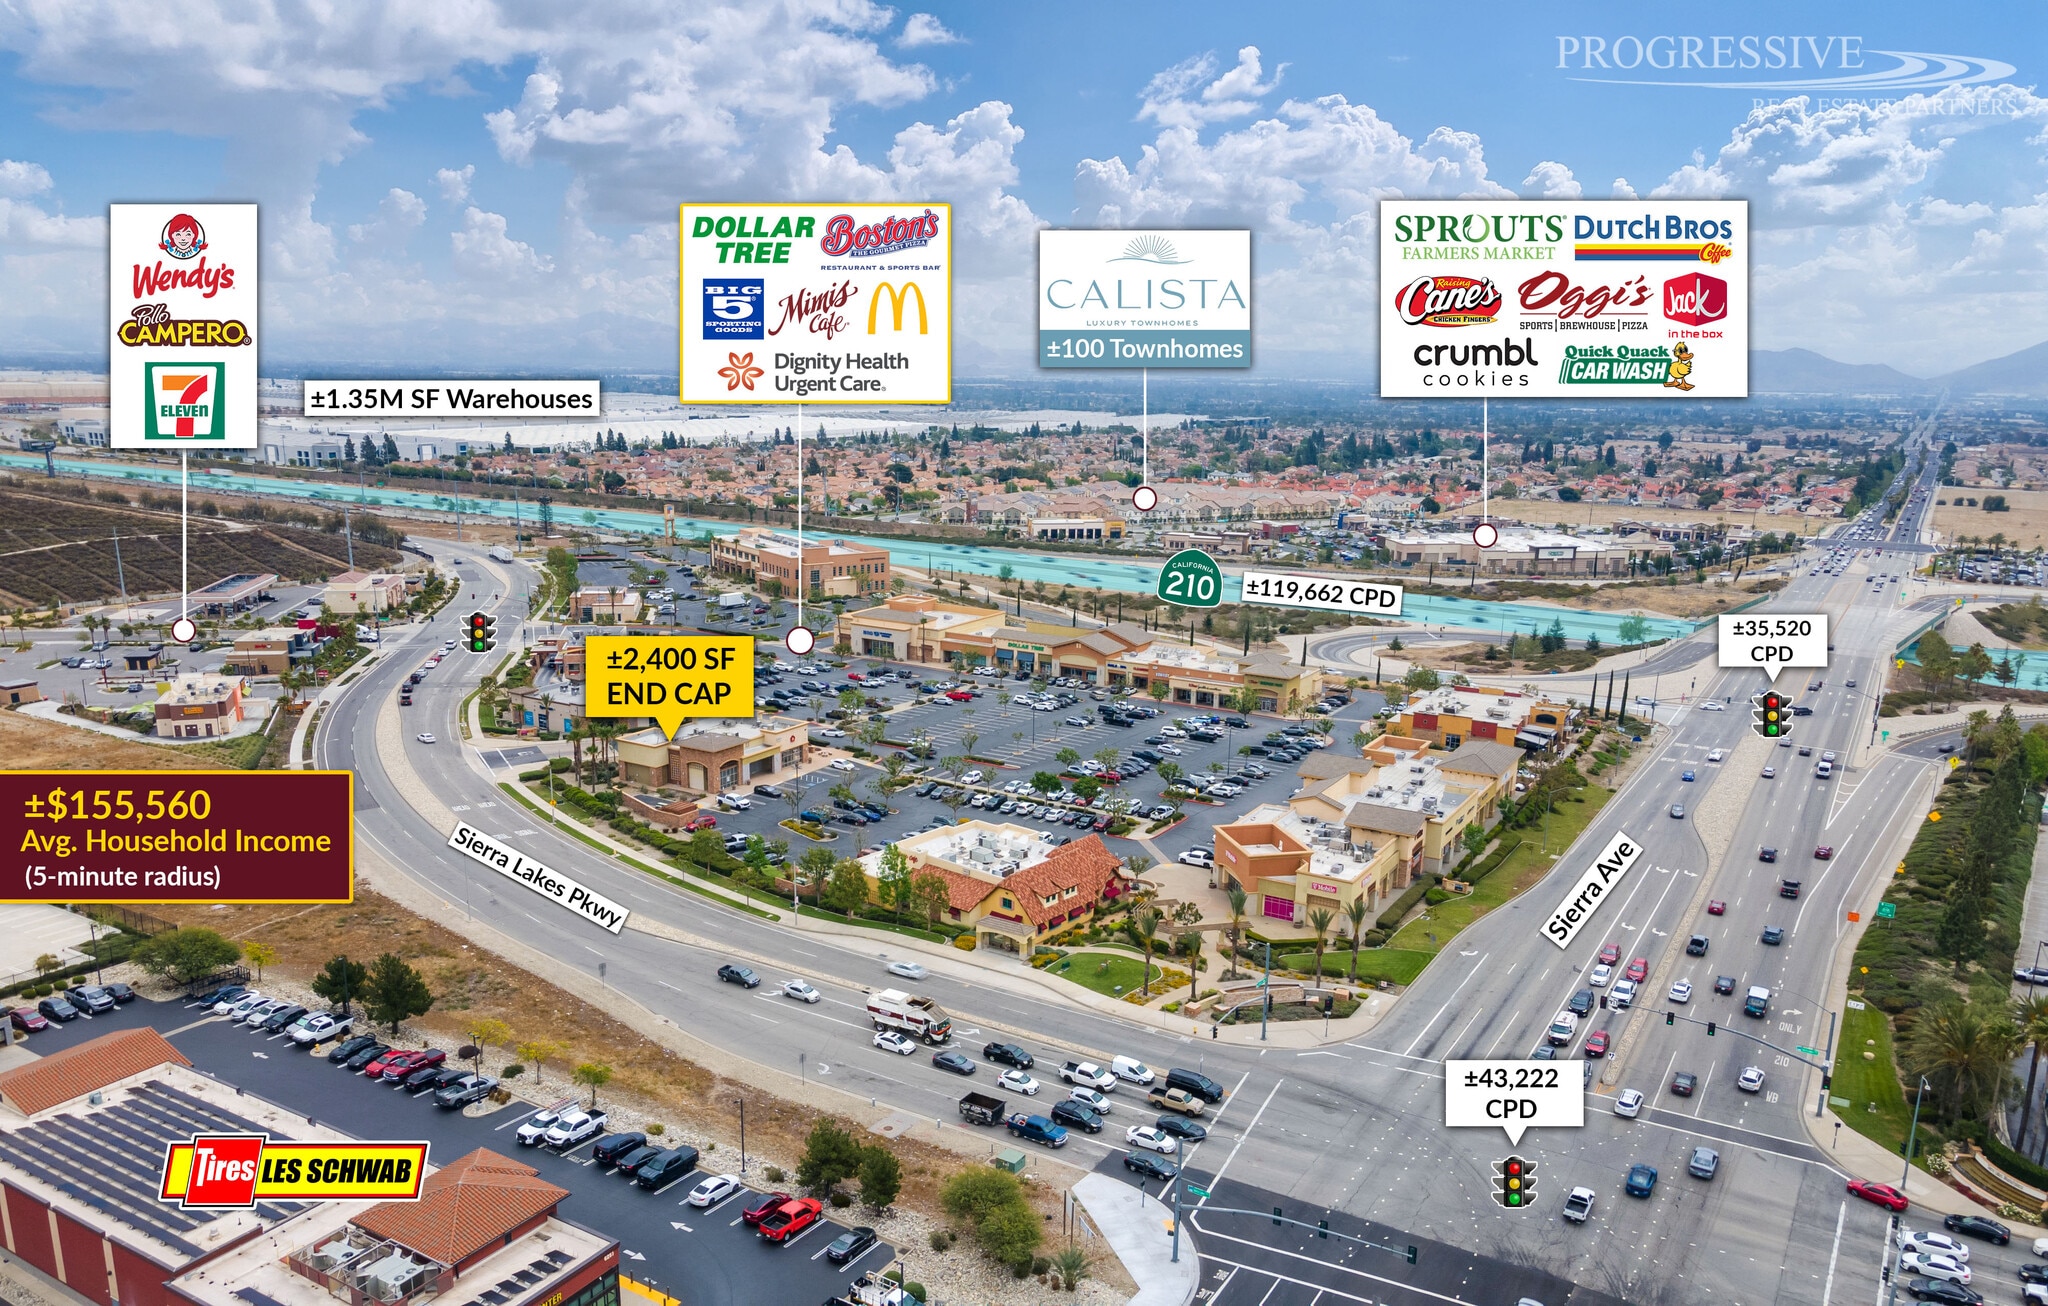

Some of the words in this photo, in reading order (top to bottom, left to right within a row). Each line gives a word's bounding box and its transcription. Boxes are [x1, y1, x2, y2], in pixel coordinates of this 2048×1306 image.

[1778, 1021, 1802, 1034] ONLY
[1774, 1055, 1790, 1067] 210
[1765, 1090, 1779, 1103] WB
